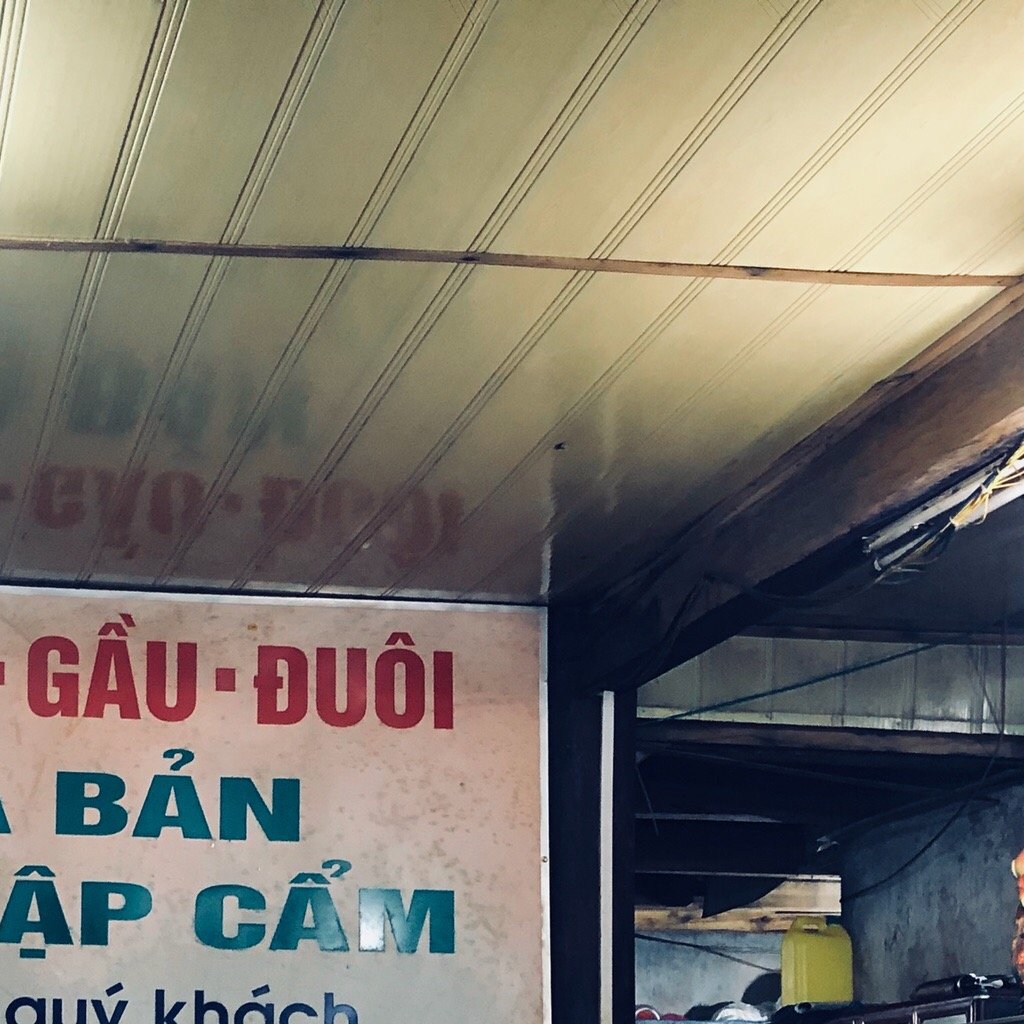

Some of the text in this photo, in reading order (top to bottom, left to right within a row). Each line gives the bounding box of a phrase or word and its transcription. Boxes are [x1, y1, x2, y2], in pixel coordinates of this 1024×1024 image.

[26, 613, 199, 723] GẦU
[254, 631, 455, 730] ĐUÔI
[54, 748, 302, 843] BẢN
[193, 859, 456, 955] CẨM
